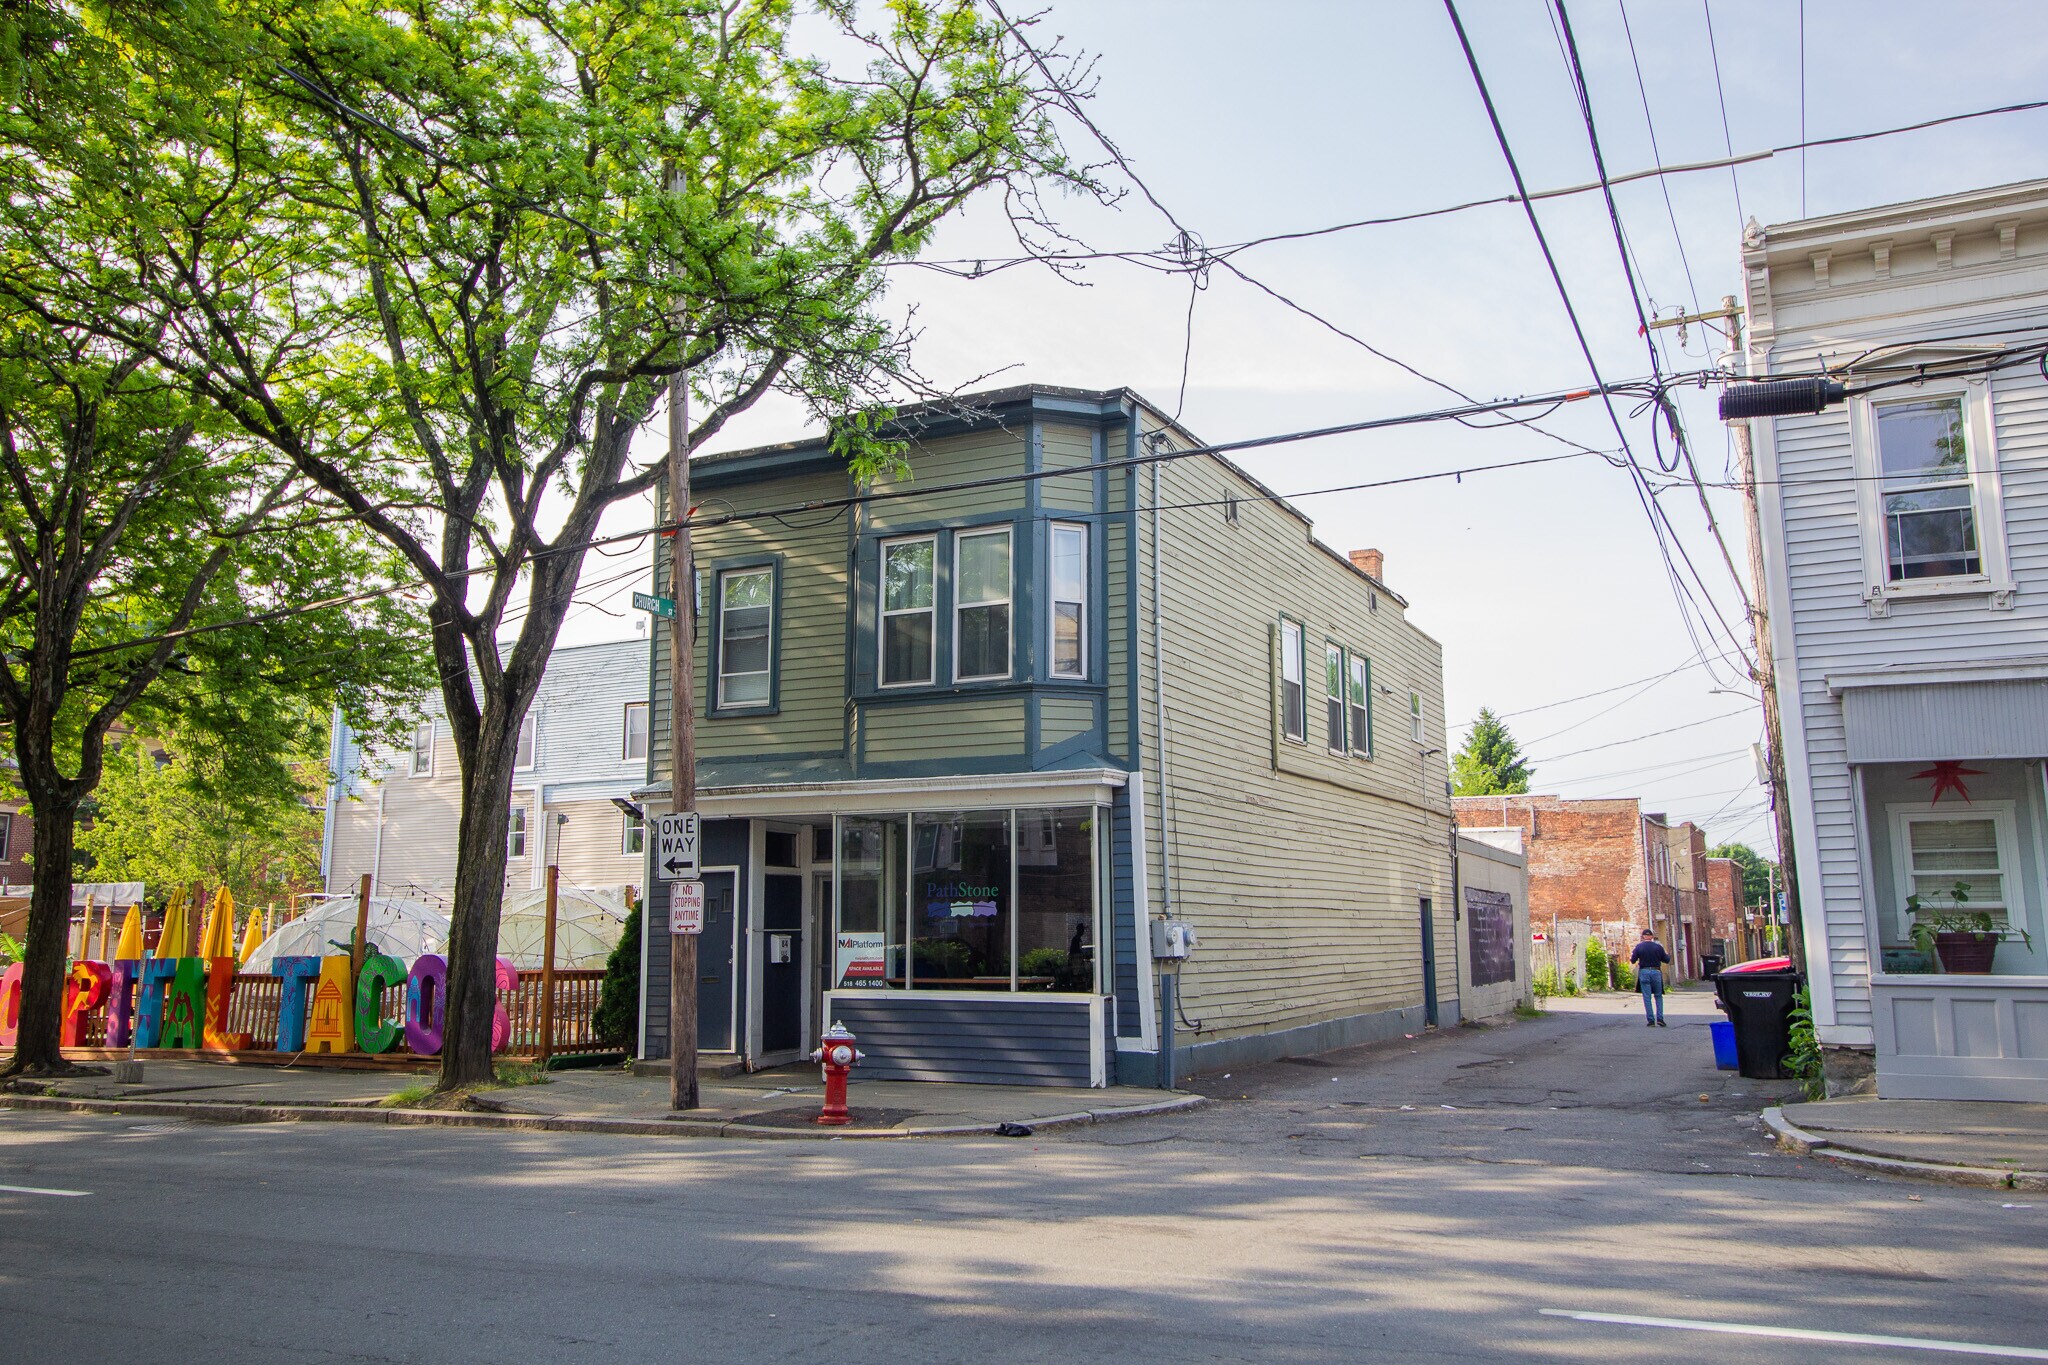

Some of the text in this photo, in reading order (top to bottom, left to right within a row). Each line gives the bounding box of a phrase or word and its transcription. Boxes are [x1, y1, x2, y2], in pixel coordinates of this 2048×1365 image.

[634, 594, 673, 616] CHURCH ST
[662, 819, 695, 835] ONE
[662, 837, 695, 853] WAY
[682, 885, 693, 895] NO
[927, 881, 999, 898] PathStone
[674, 897, 701, 908] STOPPING
[674, 910, 699, 921] ANYTIME
[854, 979, 867, 987] 465
[868, 979, 883, 987] 1400
[0, 957, 250, 1050] CPITAL
